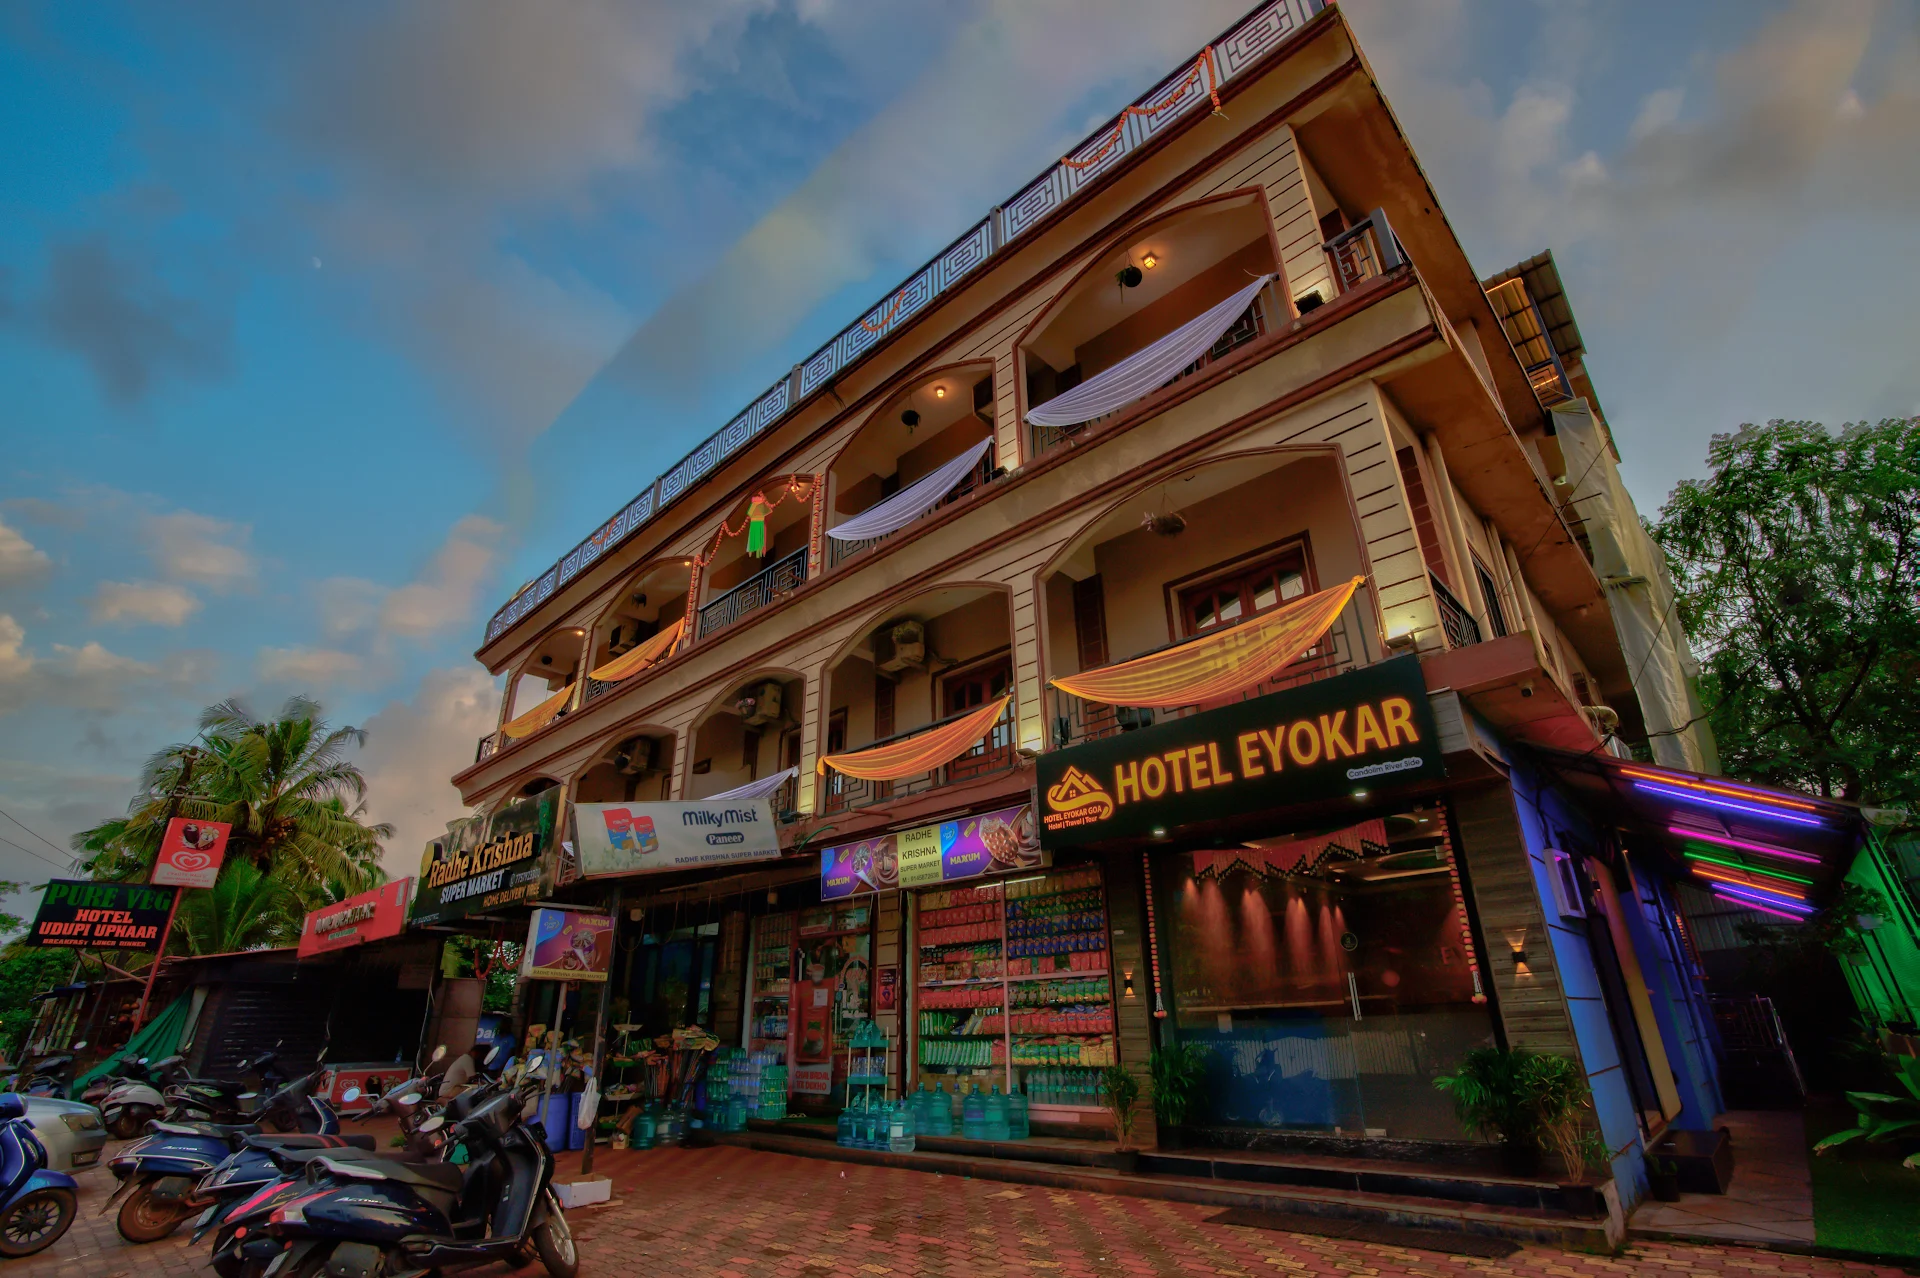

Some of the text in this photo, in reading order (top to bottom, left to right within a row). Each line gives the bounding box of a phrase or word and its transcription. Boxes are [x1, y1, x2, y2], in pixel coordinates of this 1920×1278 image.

[1114, 696, 1420, 805] HOTEL EYOKAR
[1347, 757, 1421, 779] Candolim River Side
[1044, 805, 1102, 823] HOTEL EYOKAR GOA
[1048, 822, 1063, 831] Hotel
[1065, 818, 1082, 827] Travel
[708, 833, 744, 845] Paneer
[905, 829, 933, 843] RADHE
[428, 831, 533, 889] Radhe Krishna
[674, 849, 778, 864] RADHE KRISHNA SUPER MARKET
[901, 845, 937, 860] KRISHNA
[900, 860, 941, 873] SUPER MARKET
[440, 869, 505, 905] SUPER MARKET
[46, 884, 171, 910] PURE VEG
[482, 891, 500, 907] HOME
[499, 886, 526, 903] DELIVERY
[76, 909, 133, 924] HOTEL
[38, 921, 157, 939] UDUPI UPHAAR
[43, 938, 88, 946] BREAKFAST
[795, 1070, 829, 1081] CHAI BADAL
